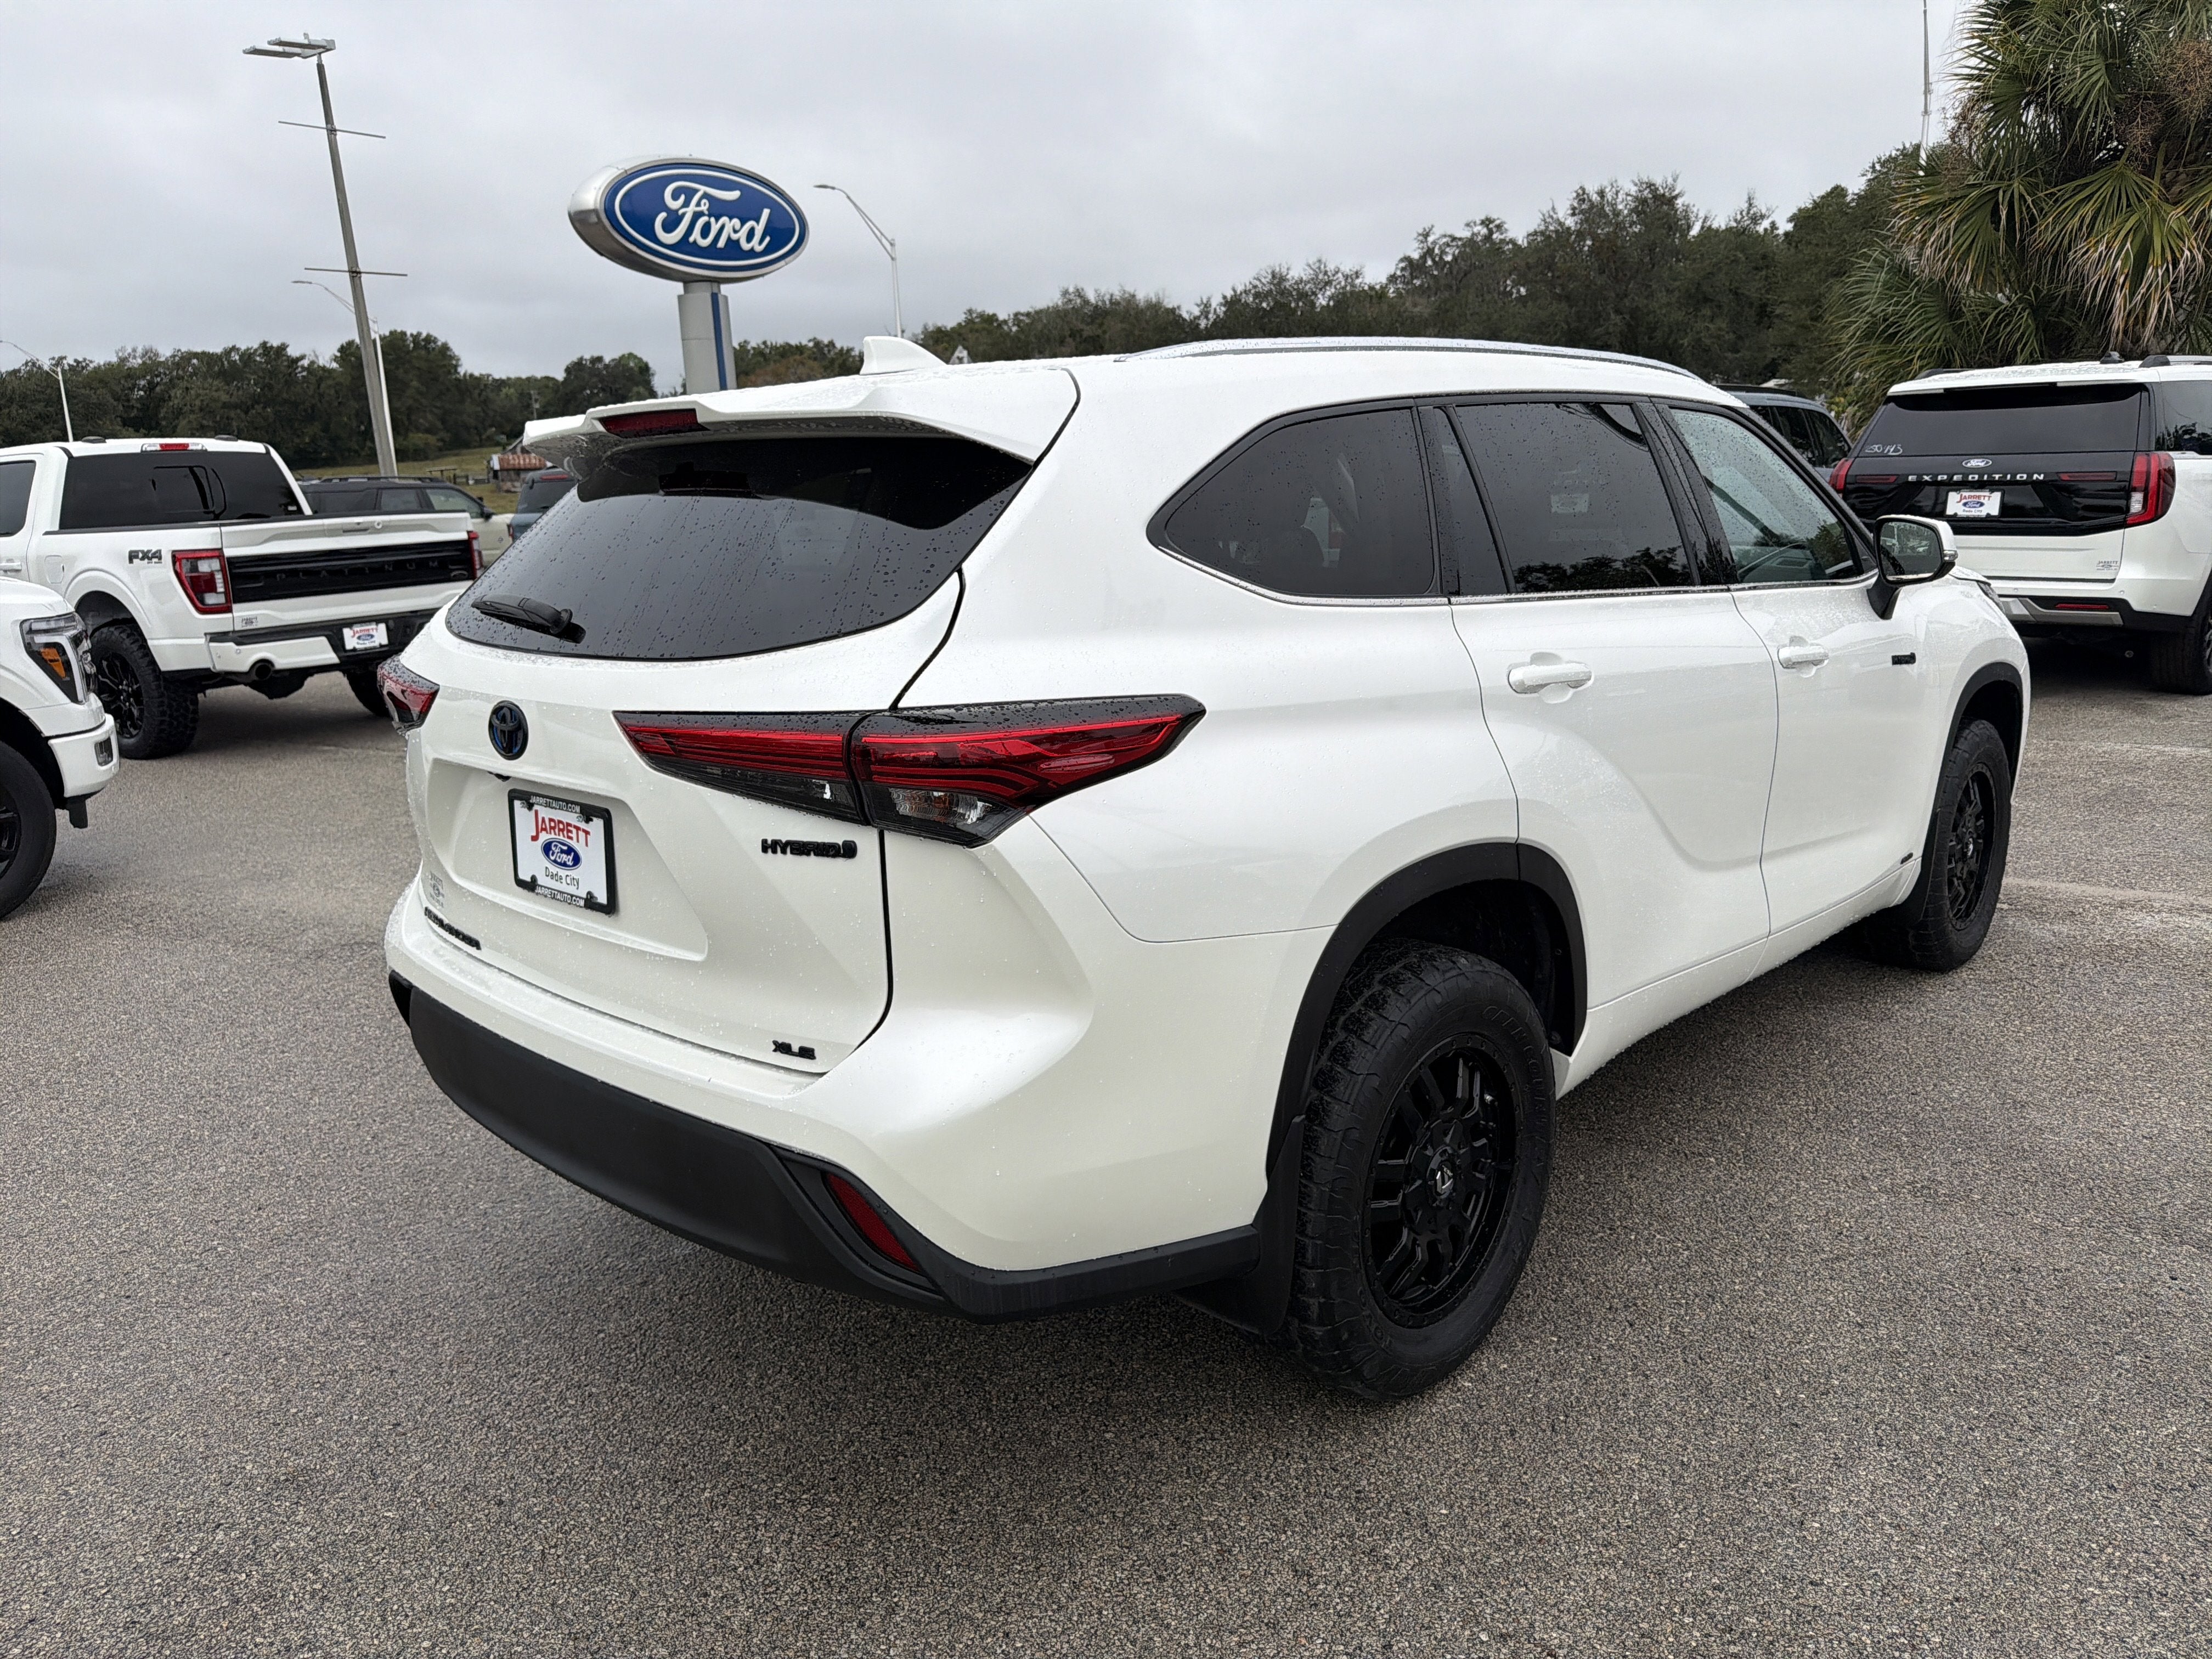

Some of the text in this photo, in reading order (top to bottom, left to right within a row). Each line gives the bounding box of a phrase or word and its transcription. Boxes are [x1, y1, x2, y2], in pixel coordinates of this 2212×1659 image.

[654, 181, 770, 253] Ford
[1908, 473, 2044, 482] EXPEDITION
[1956, 493, 1992, 503] JARRETT
[128, 549, 162, 564] FX4
[276, 560, 438, 581] PLATINUM
[529, 795, 580, 813] JARRETTAUTO.COM
[531, 809, 591, 848] JARRETT
[549, 842, 574, 866] Ford
[761, 838, 842, 859] HYBRID
[545, 866, 580, 890] Dade City
[535, 885, 585, 907] JARRETTAUTO.COM
[772, 1040, 816, 1060] XLE
